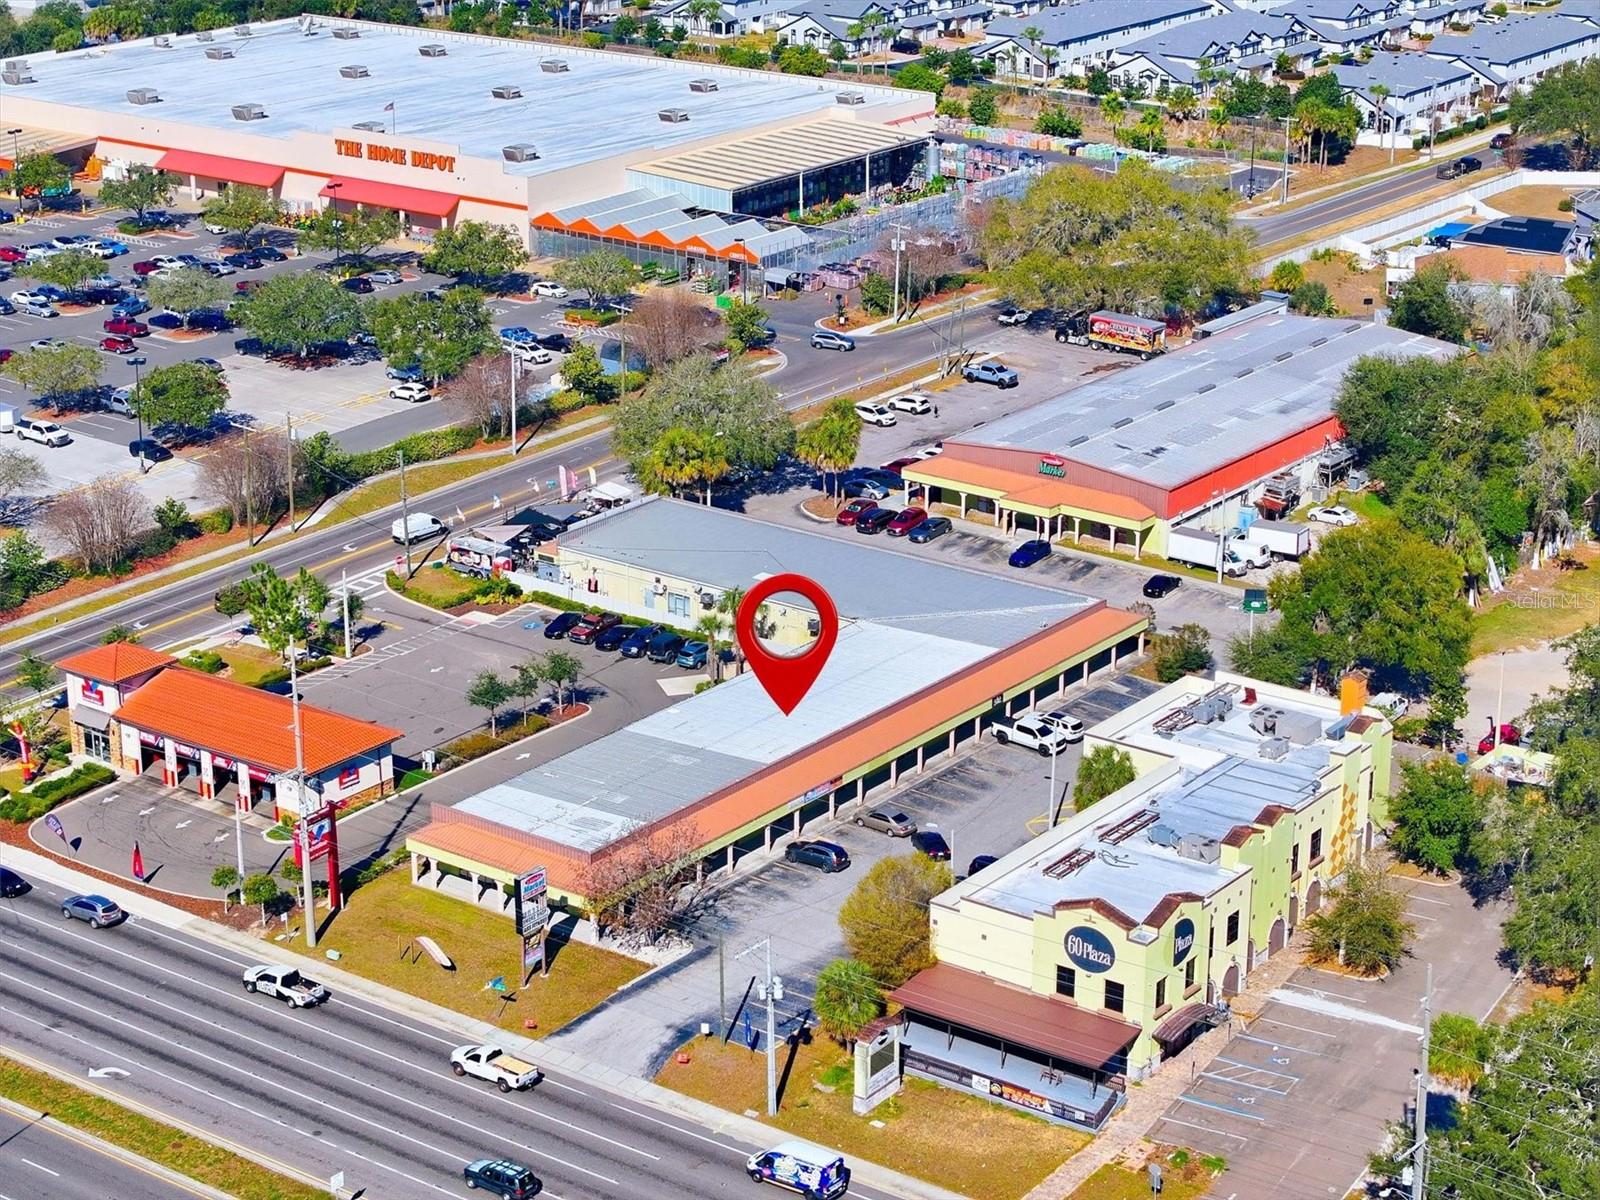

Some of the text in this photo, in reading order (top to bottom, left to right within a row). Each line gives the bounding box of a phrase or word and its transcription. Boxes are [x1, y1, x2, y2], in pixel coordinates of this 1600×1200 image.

[335, 138, 456, 173] THE HOME DEPOT
[1067, 934, 1112, 967] 60 Plaza
[1174, 933, 1193, 955] Plaza
